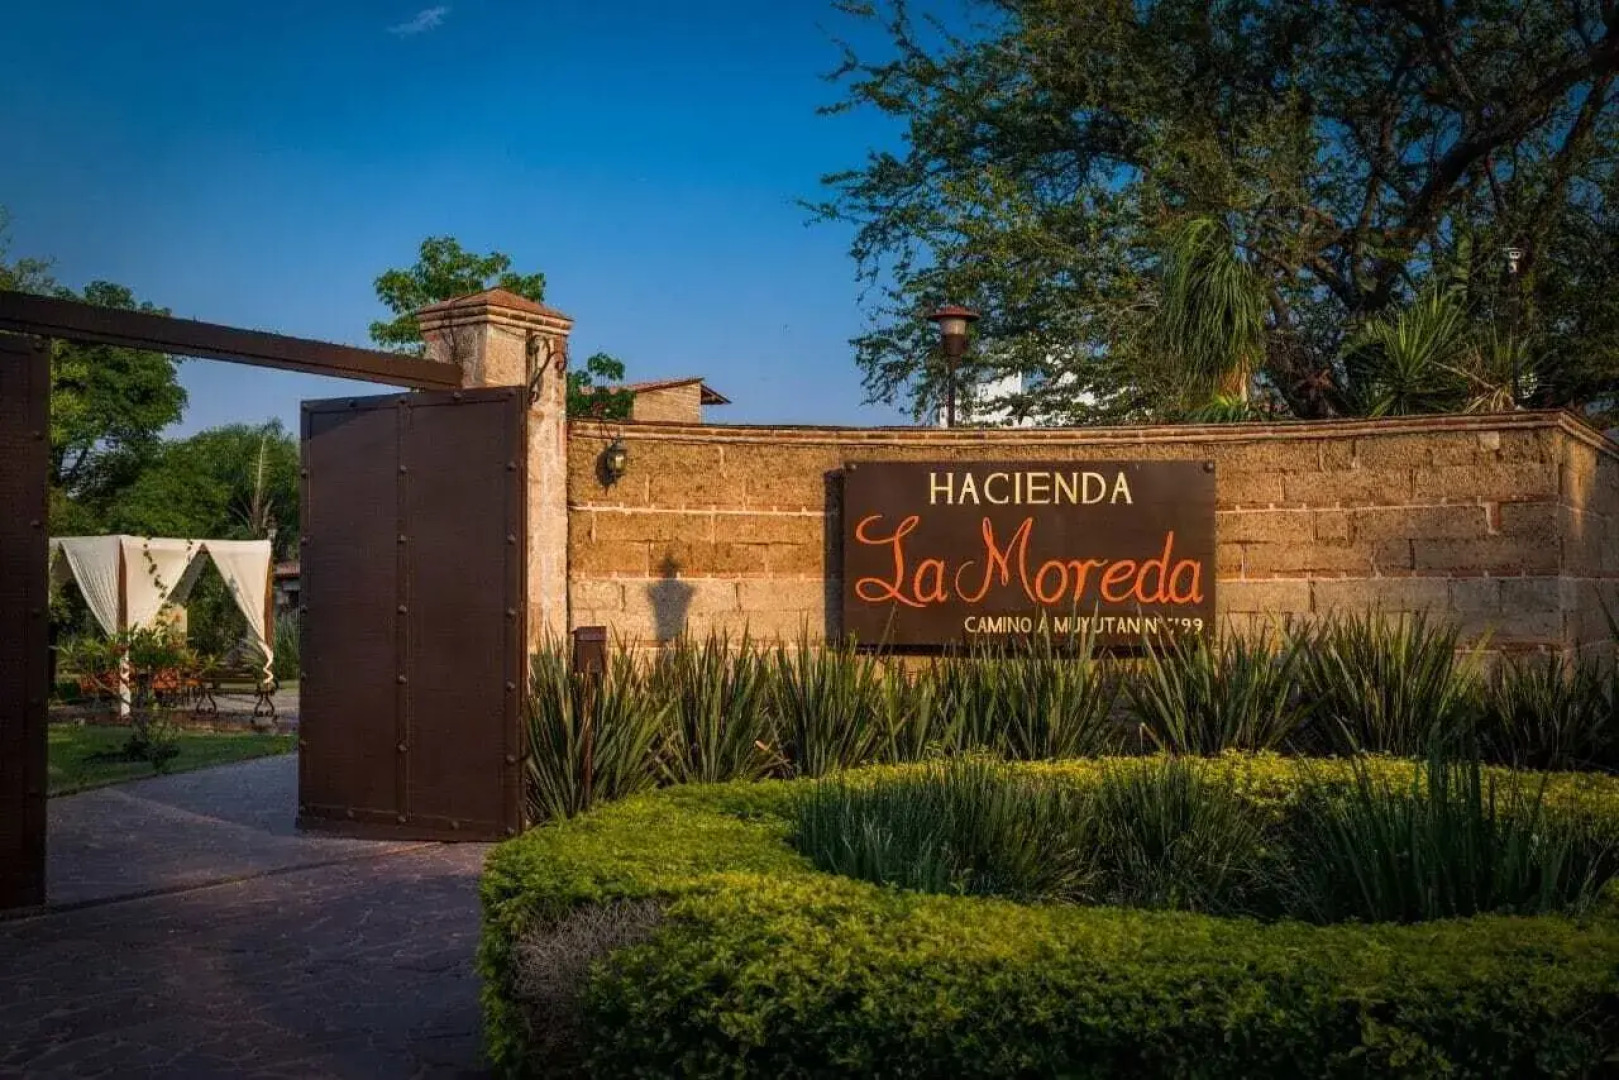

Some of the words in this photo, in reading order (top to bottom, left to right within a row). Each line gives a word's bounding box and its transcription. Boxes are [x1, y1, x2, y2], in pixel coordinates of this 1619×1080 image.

[929, 471, 1134, 505] HACIENDA
[855, 514, 948, 608] La
[955, 515, 1204, 606] Moreda
[964, 616, 1032, 635] CAMINO
[1037, 616, 1049, 634] A
